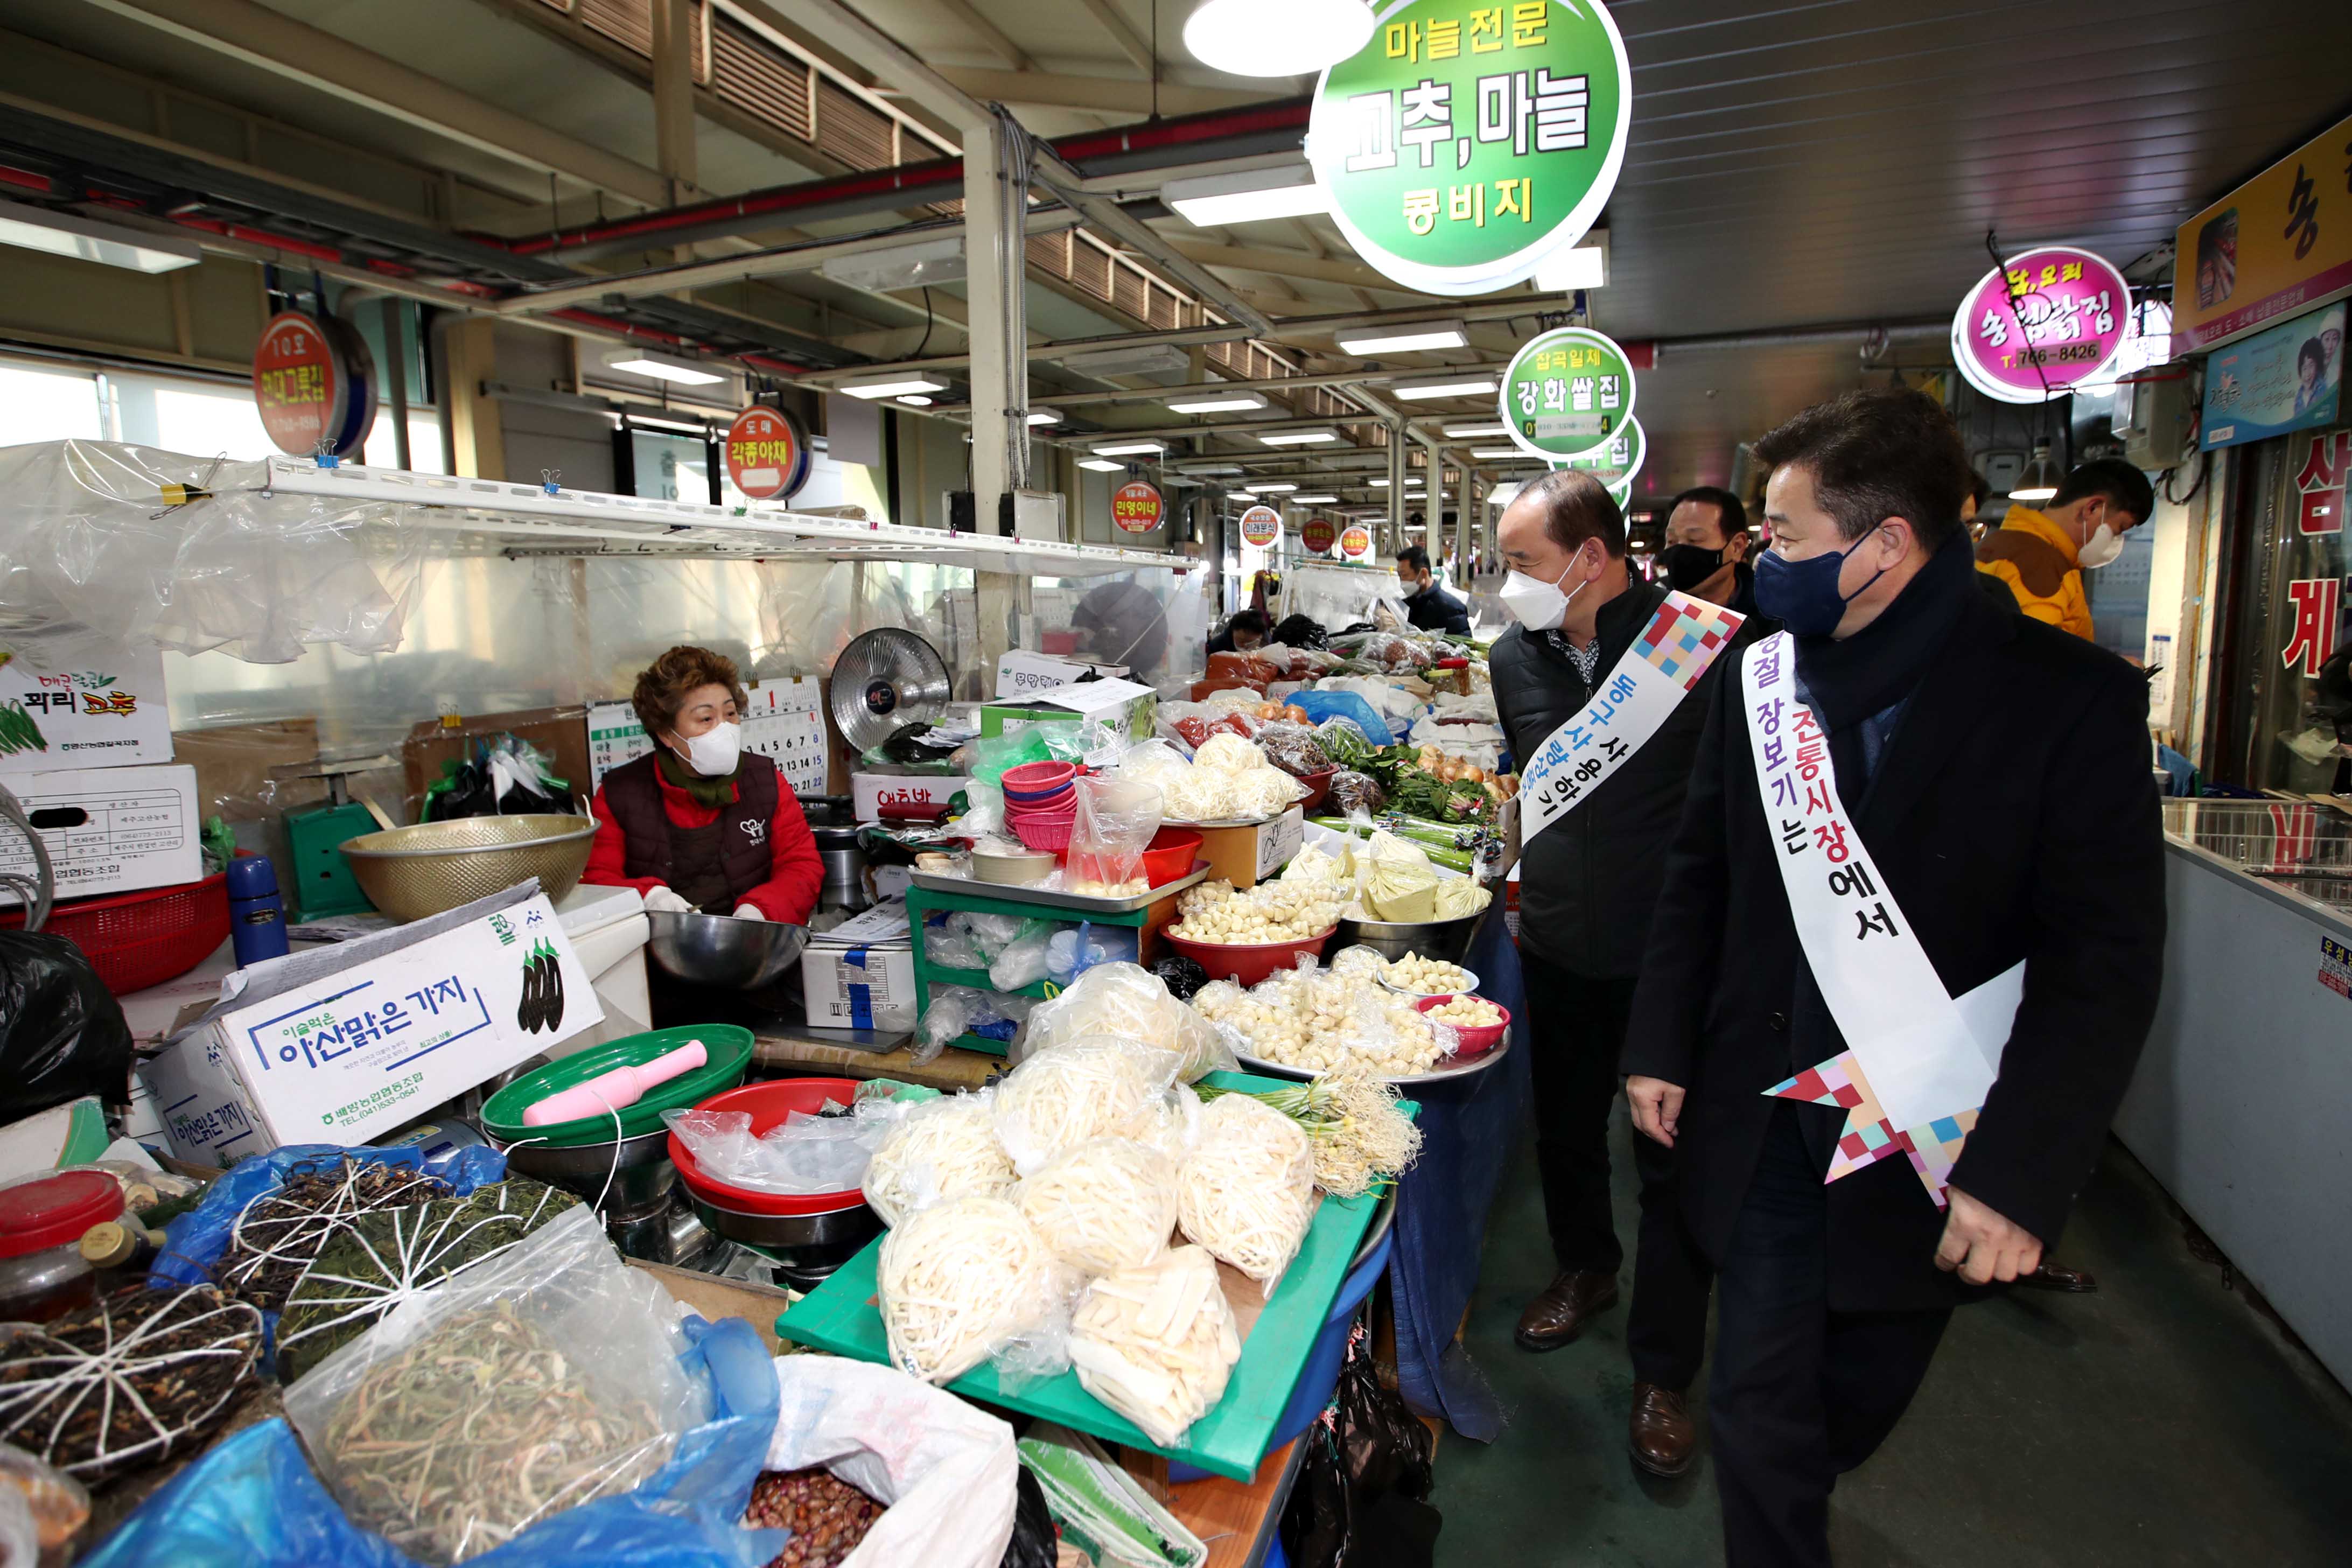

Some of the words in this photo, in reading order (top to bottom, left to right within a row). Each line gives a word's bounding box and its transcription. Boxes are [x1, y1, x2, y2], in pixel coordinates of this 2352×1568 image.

[1385, 1, 1548, 64] 마늘전문
[1346, 67, 1590, 173] 고추,마늘
[1402, 178, 1532, 235] 콩비지
[1517, 374, 1620, 416] 강화쌀집
[745, 420, 772, 435] 도매
[731, 439, 787, 467] 각종야채
[1116, 501, 1157, 516] 민영이네
[1244, 521, 1276, 535] 미래분식
[761, 743, 766, 753] 4
[773, 740, 779, 751] 5
[786, 738, 792, 748] 6
[800, 736, 805, 746] 7
[813, 734, 819, 744] 8
[787, 760, 797, 771] 13
[800, 758, 810, 768] 14
[813, 755, 822, 766] 15
[802, 780, 810, 790] 21
[813, 776, 822, 787] 22
[1538, 736, 1630, 817] 사용하기
[1756, 697, 1808, 856] 장보기는
[1792, 709, 1899, 941] 전통시장에서
[279, 1001, 412, 1069] 아산맑은
[405, 975, 467, 1016] 가지
[282, 1012, 337, 1039] 이슬먹은
[418, 1035, 438, 1048] 최고의
[335, 1072, 424, 1118] 배방농업협동조합
[340, 1086, 420, 1128] TEL.(041)533-0541
[177, 1112, 224, 1148] 아산맑은
[214, 1101, 243, 1130] 가지
